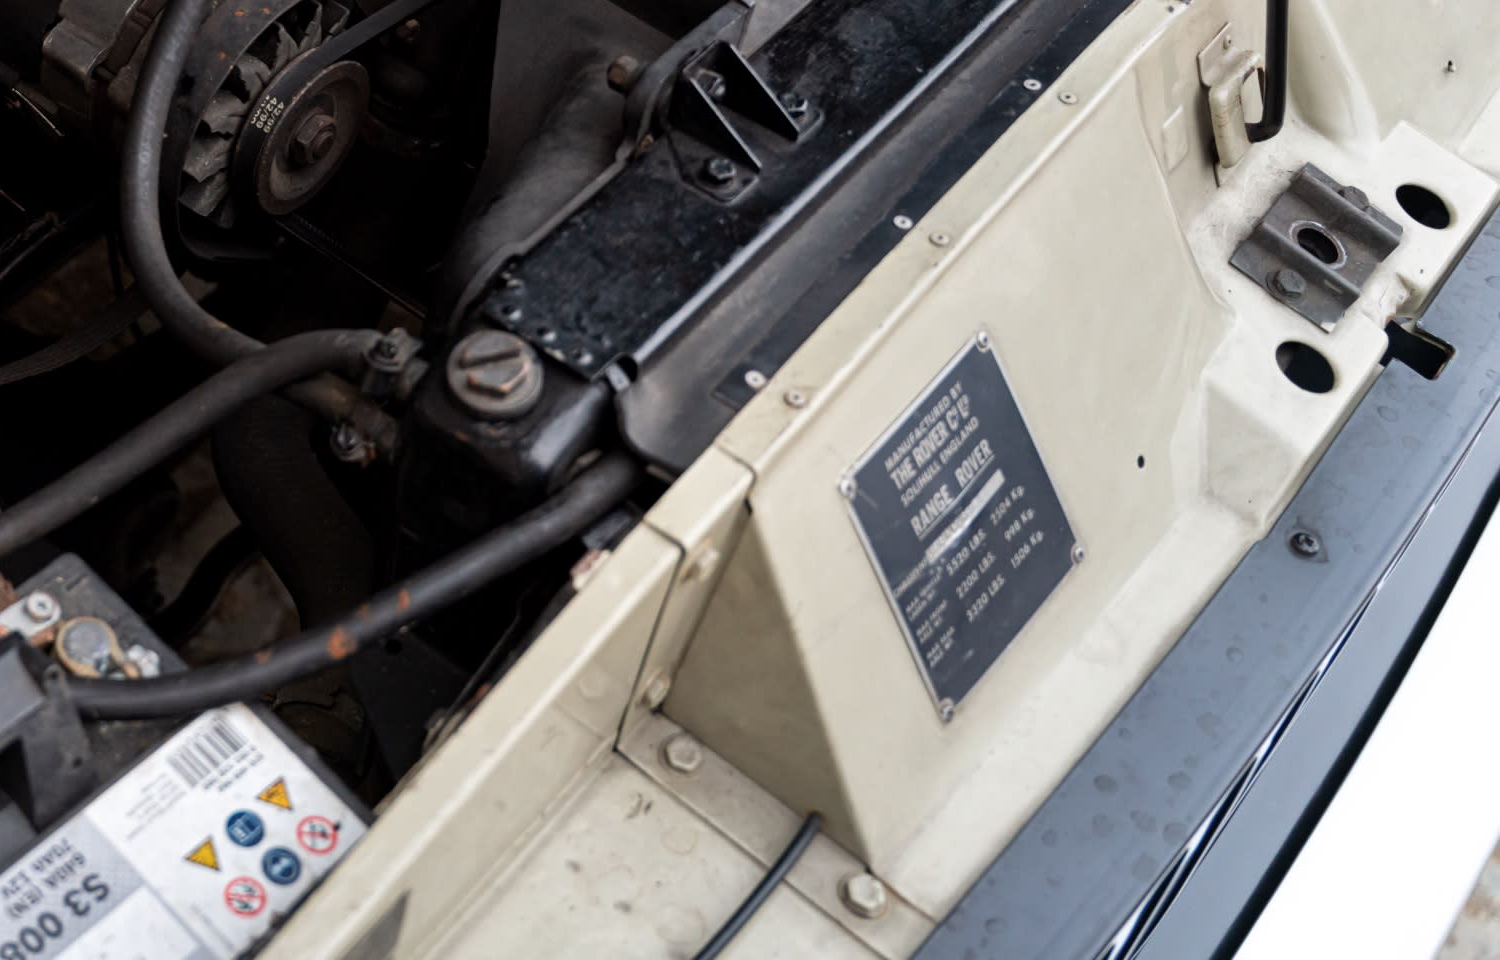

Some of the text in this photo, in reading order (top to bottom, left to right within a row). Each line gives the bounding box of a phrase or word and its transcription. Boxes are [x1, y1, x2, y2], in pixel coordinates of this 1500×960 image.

[255, 97, 277, 129] 42/99
[263, 101, 285, 133] 42/99
[884, 380, 962, 471] MANUFACTURED BY
[890, 455, 916, 493] THE
[912, 419, 949, 469] ROVER
[900, 457, 941, 508] SOLIHULL
[938, 414, 979, 465] ENGLAND
[910, 481, 953, 539] RANGE
[954, 436, 992, 489] ROVER
[955, 567, 979, 600] 2200
[63, 873, 110, 916] S3
